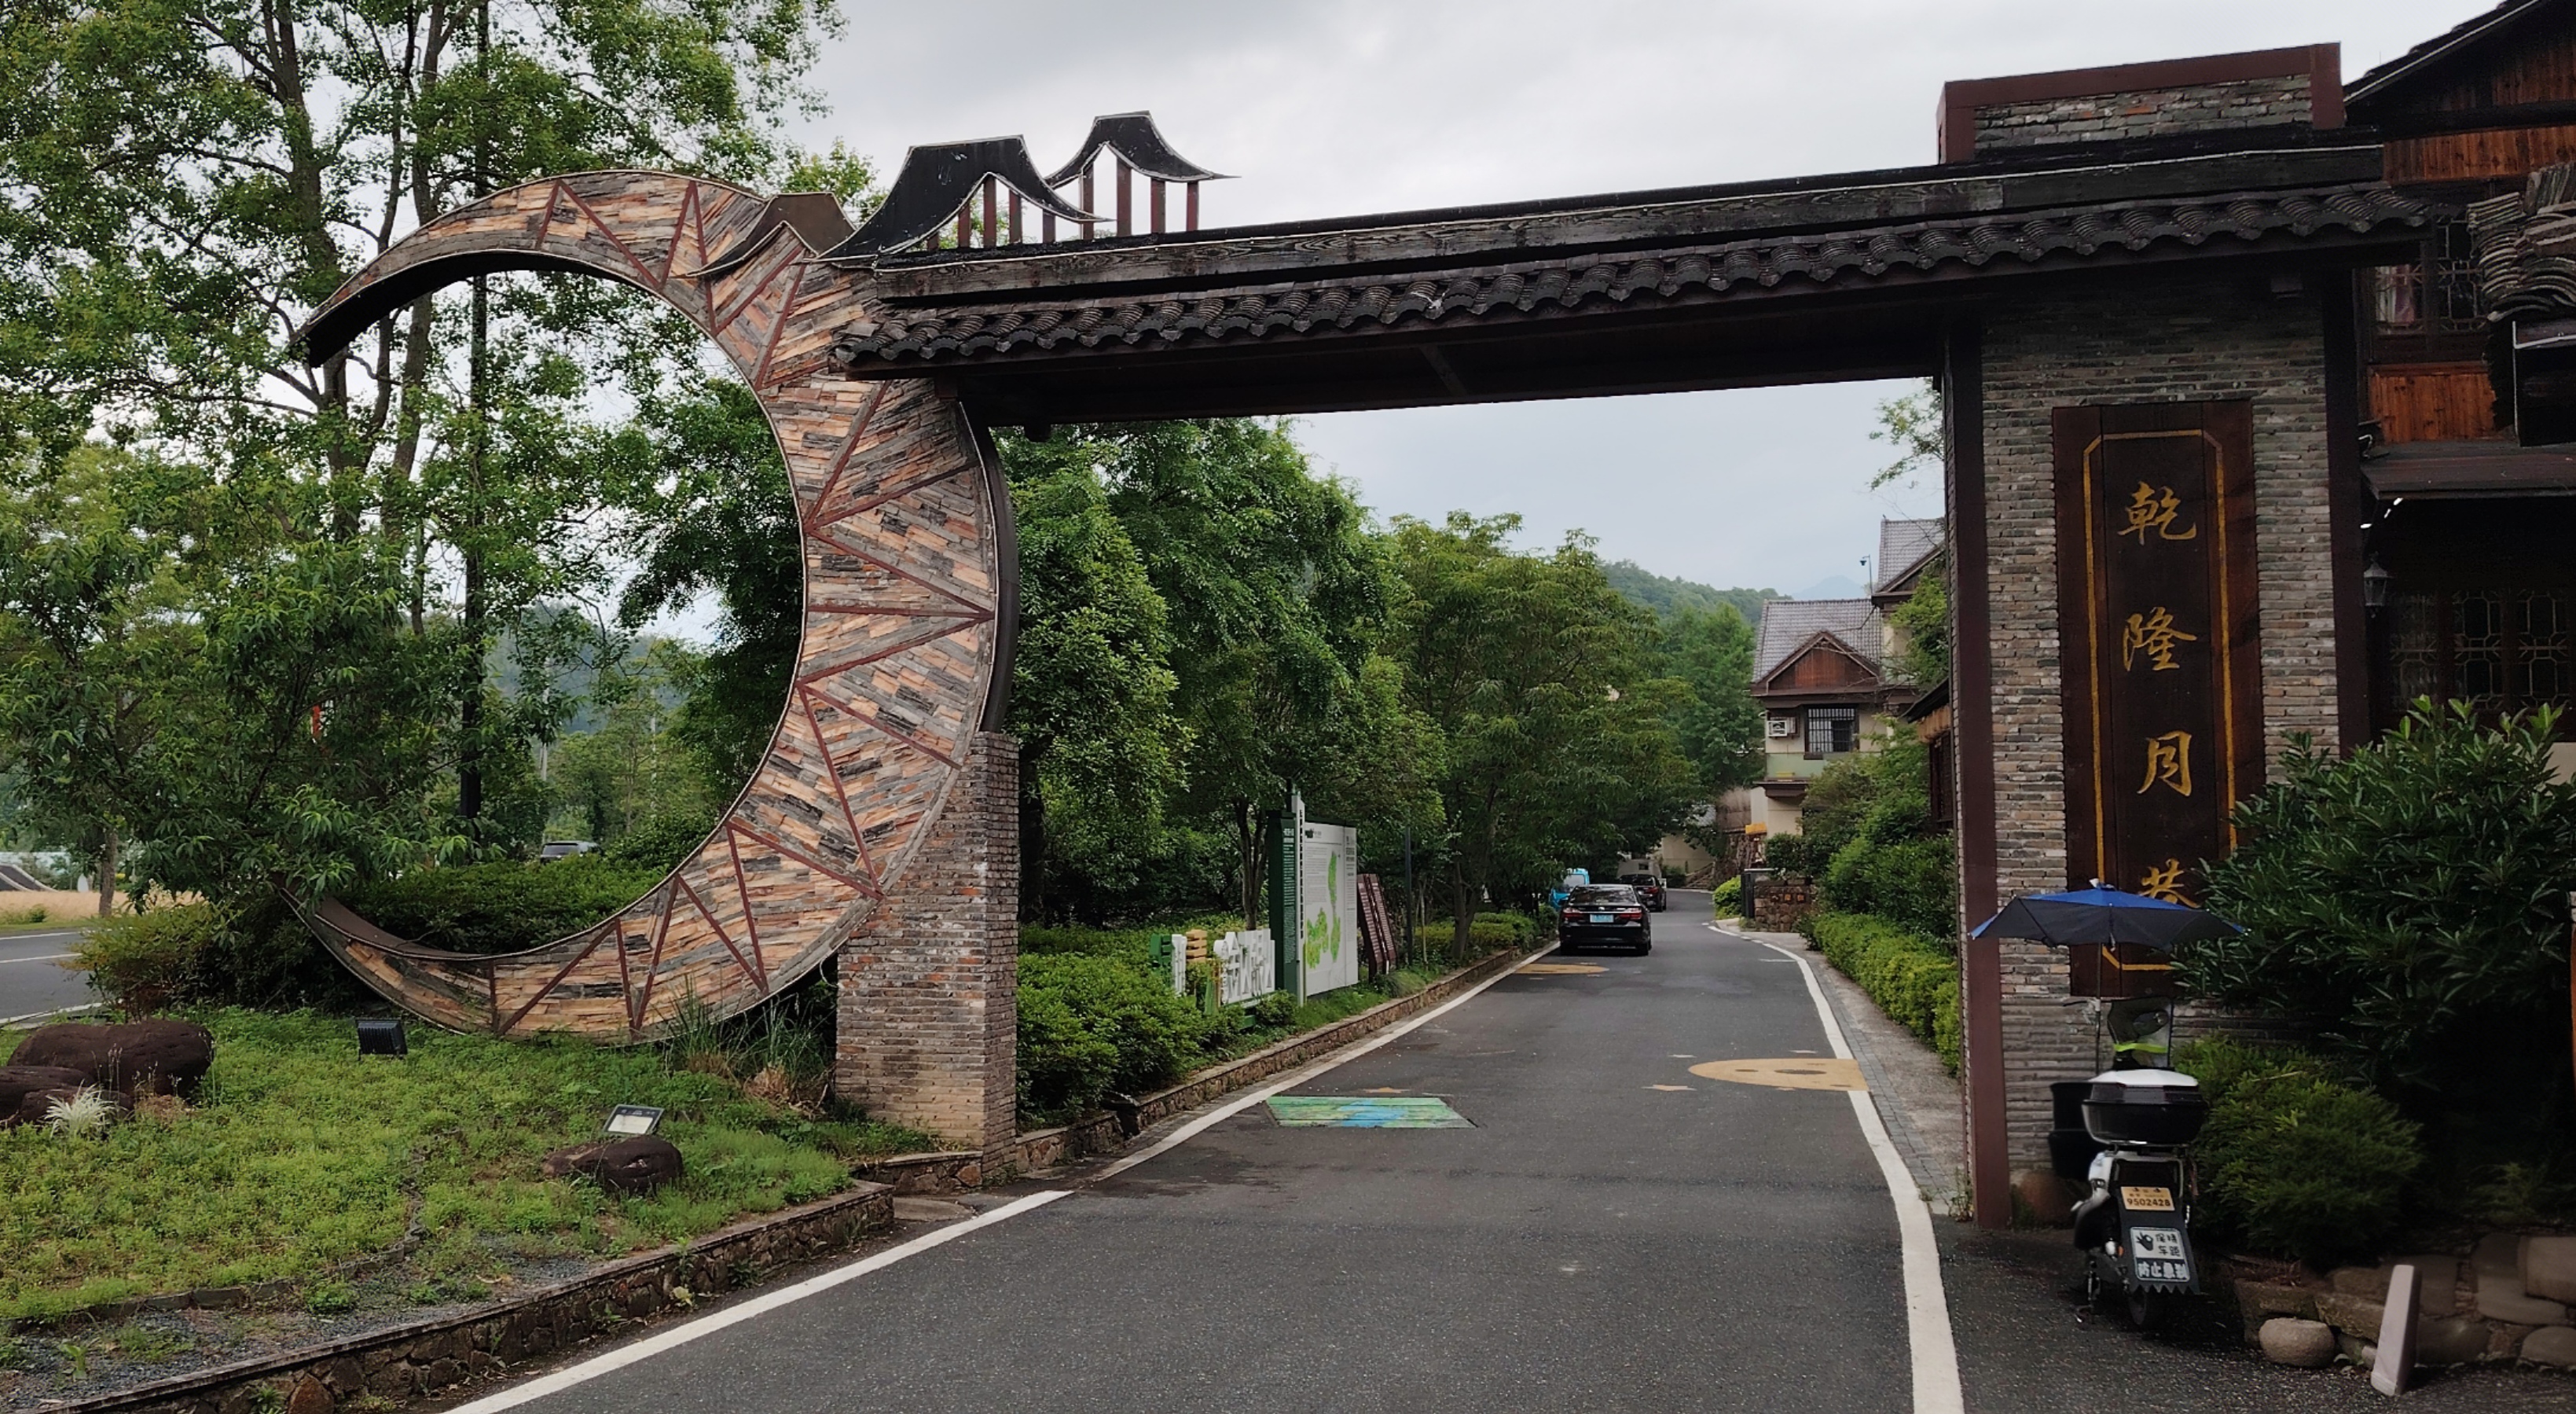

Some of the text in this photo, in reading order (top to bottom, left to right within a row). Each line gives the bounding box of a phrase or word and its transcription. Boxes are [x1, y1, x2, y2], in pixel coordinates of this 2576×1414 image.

[2126, 1198, 2171, 1206] 9502428
[2156, 1232, 2178, 1243] 保持
[2159, 1245, 2182, 1257] 车距
